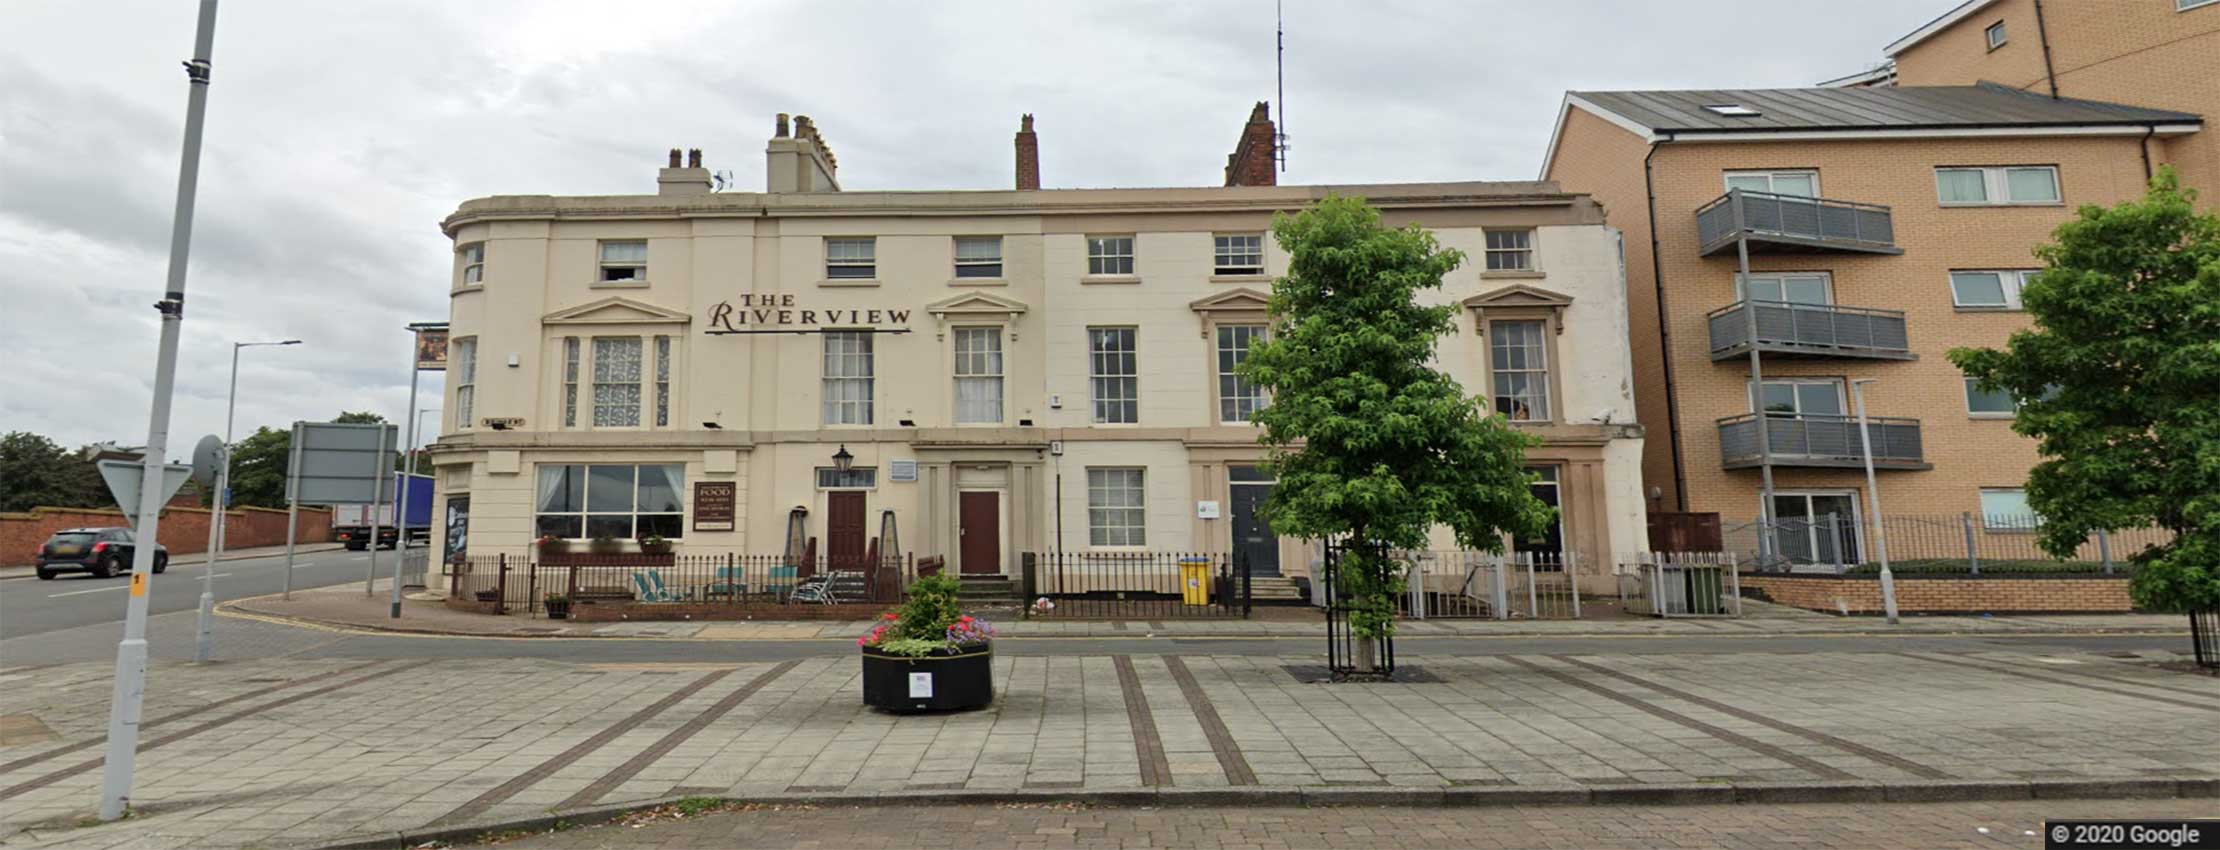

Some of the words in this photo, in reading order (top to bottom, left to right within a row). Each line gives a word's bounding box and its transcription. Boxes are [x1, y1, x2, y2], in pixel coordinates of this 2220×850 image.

[740, 294, 795, 307] THE
[708, 301, 911, 332] RIVERVIEW
[700, 488, 731, 497] FOOD
